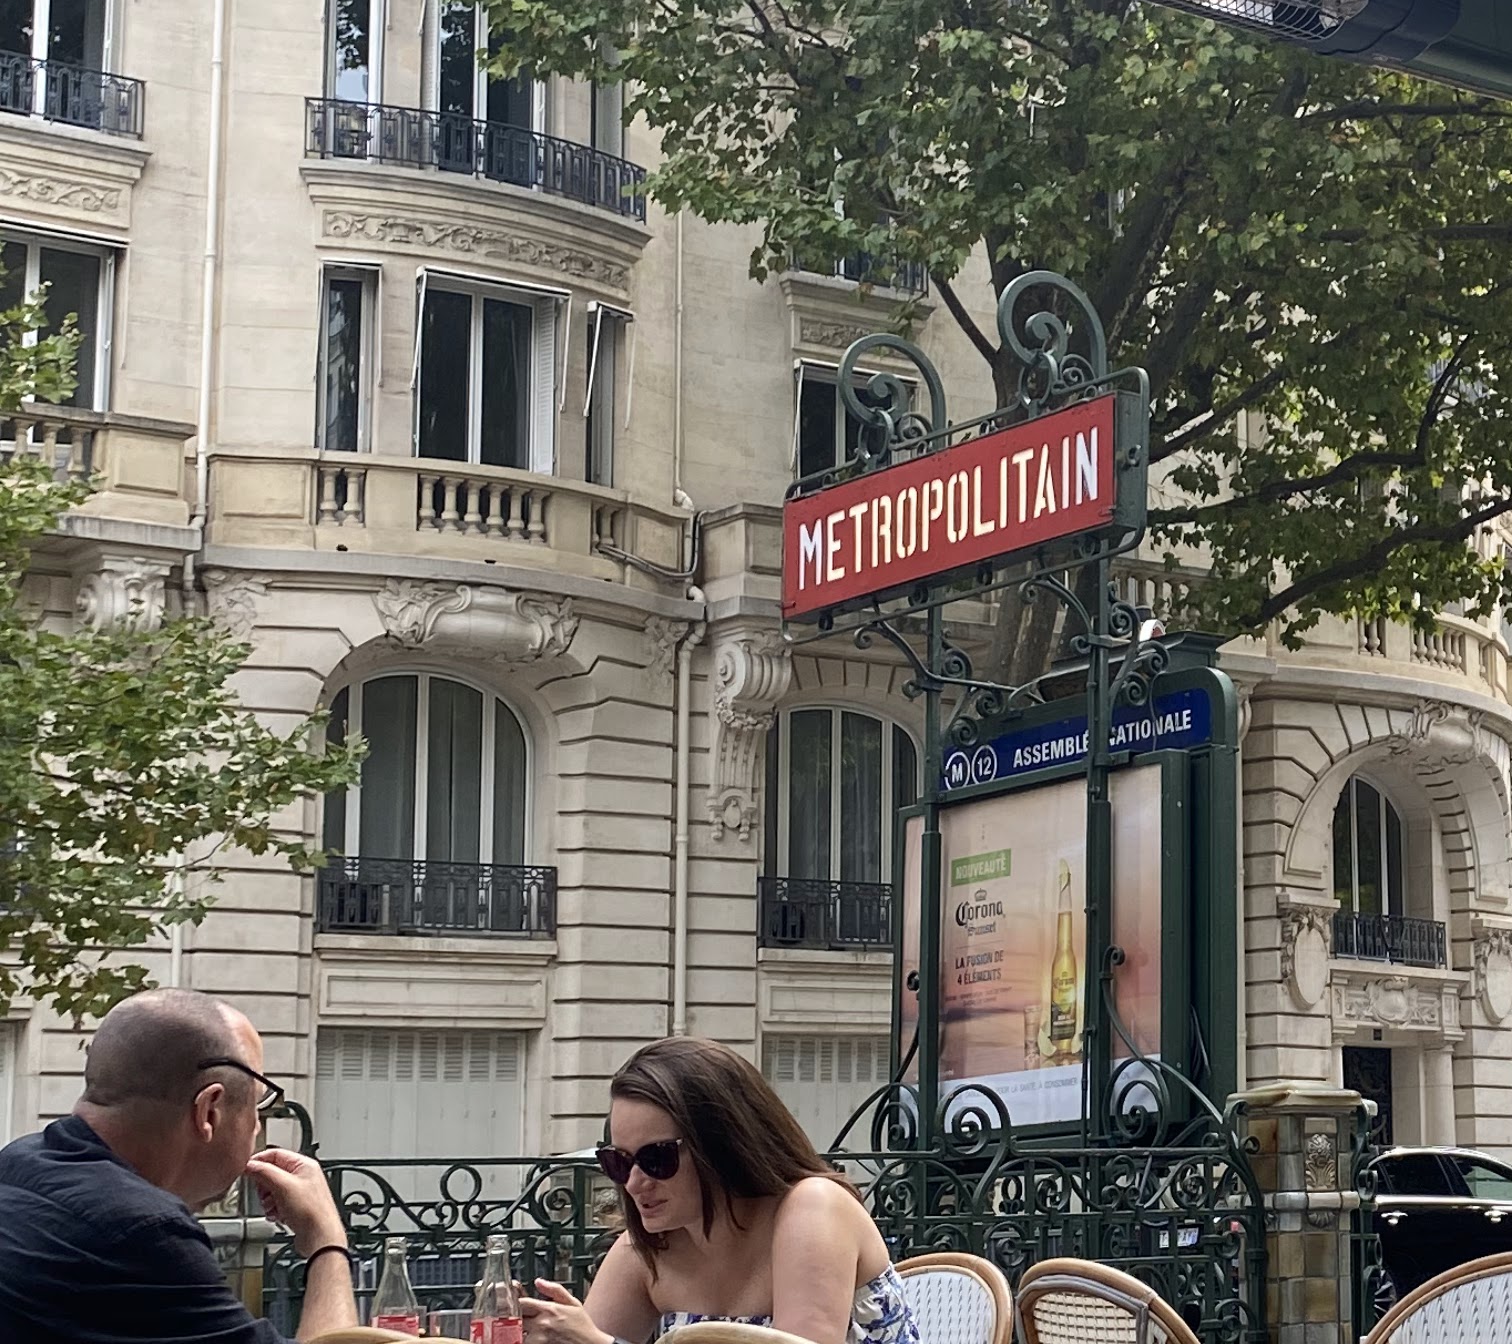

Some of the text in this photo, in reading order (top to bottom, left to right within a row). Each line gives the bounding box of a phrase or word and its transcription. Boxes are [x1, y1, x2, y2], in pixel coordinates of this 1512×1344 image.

[798, 426, 1099, 591] METROPOLITAIN
[951, 762, 963, 783] M
[977, 755, 992, 776] 12
[1013, 729, 1090, 768] ASSEMBLÉ
[955, 856, 1007, 880] NOUVEAUTÉ
[955, 900, 1003, 928] Corona
[955, 949, 1005, 970] LA FUSION DE
[957, 968, 1002, 986] 4 ÉLÉMENTS
